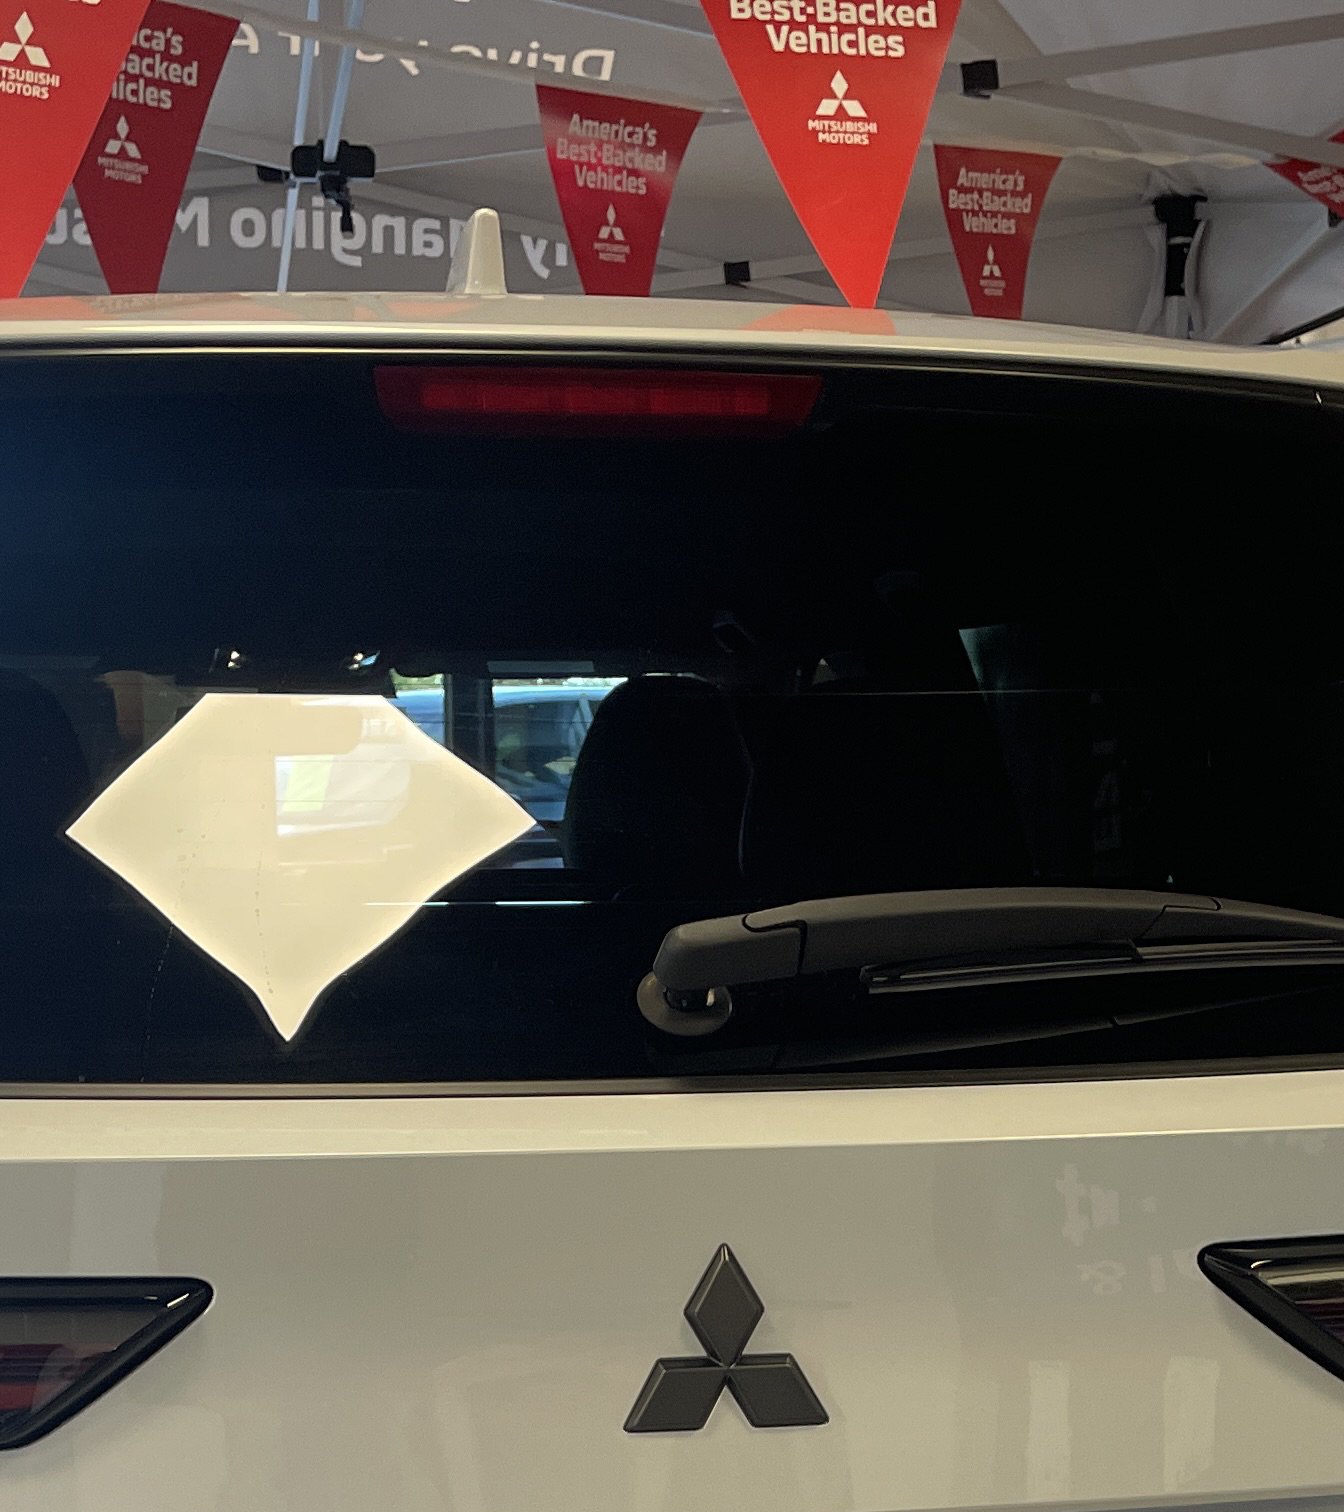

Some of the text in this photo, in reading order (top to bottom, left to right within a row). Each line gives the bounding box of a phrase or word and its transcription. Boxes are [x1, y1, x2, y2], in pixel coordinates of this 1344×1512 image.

[765, 24, 905, 58] Vehicles
[568, 112, 658, 148] America's
[807, 119, 878, 135] MITSUBISHI
[818, 131, 870, 145] MOTORS
[556, 138, 668, 173] Best-Backed
[574, 164, 647, 195] Vehicles
[957, 166, 1025, 191] America's
[948, 188, 1033, 213] Best-Backed
[962, 211, 1016, 235] Vehicles
